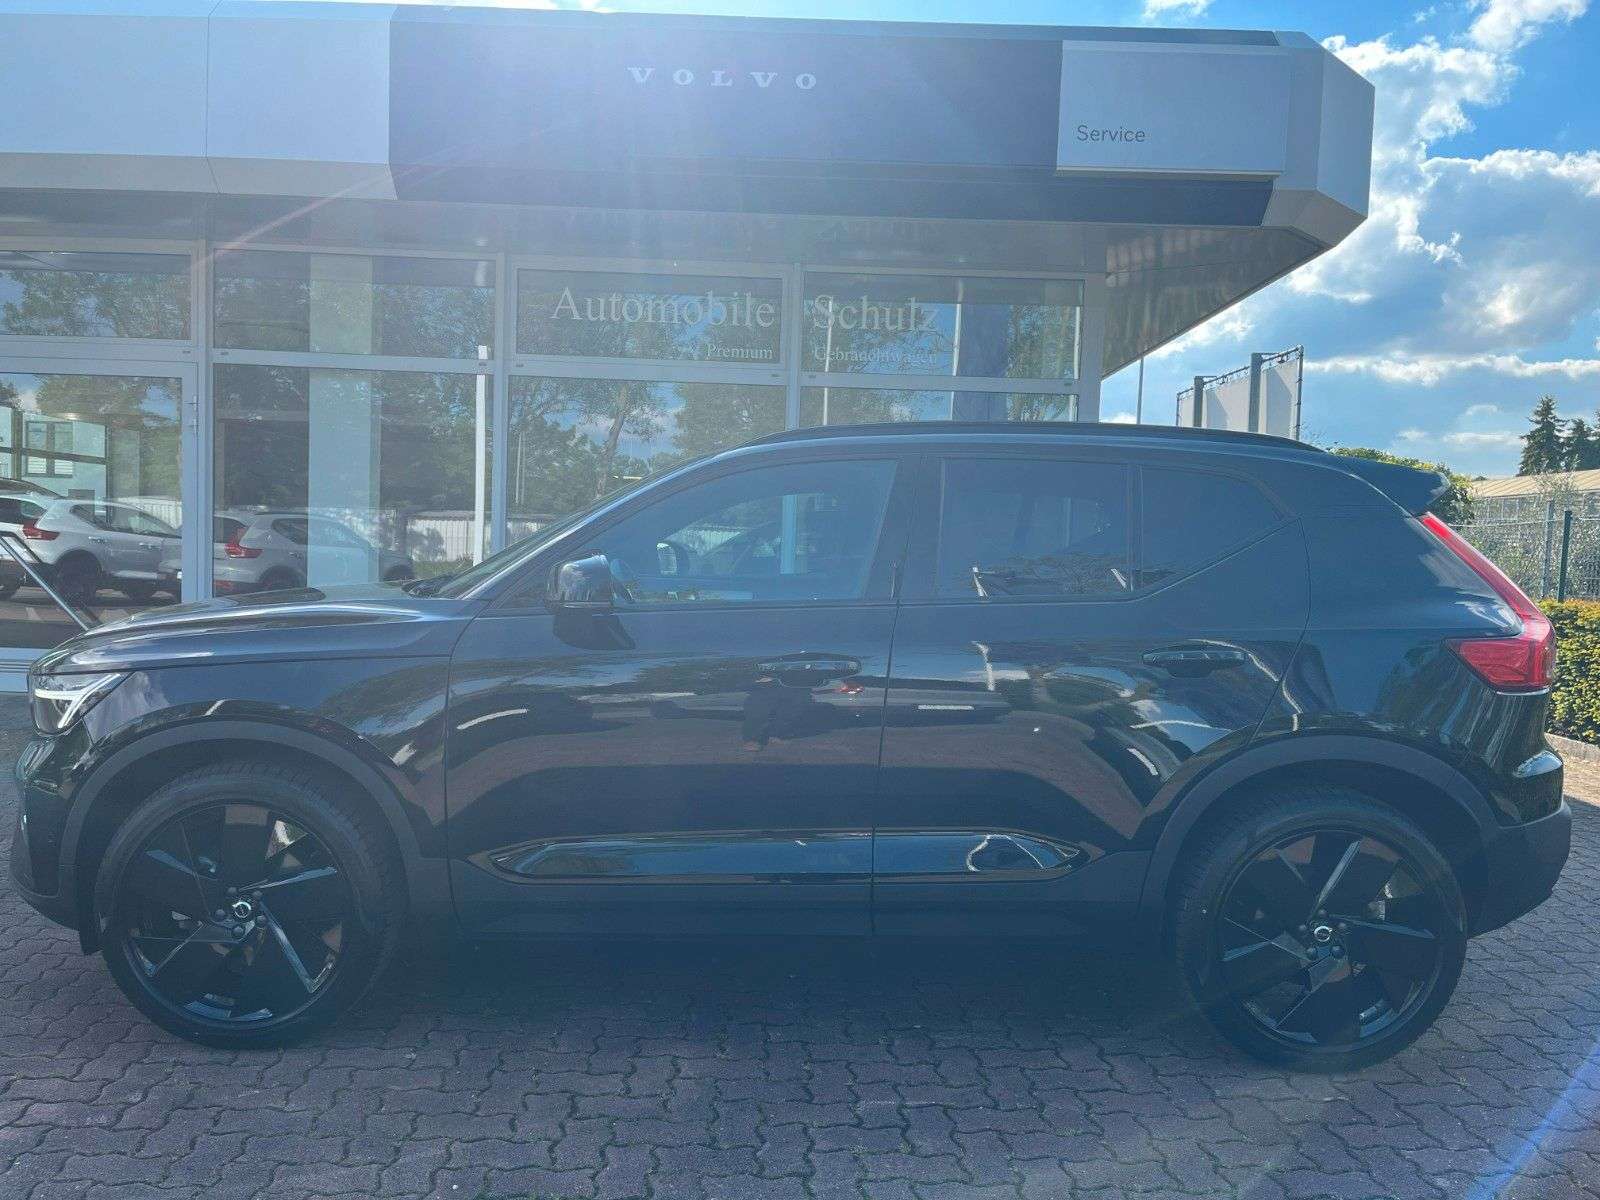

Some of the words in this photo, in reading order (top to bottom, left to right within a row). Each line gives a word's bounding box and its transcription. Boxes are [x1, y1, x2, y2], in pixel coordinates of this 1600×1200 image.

[627, 67, 817, 90] VOLVO
[1076, 124, 1146, 142] Service
[551, 286, 776, 328] Automobile
[813, 294, 938, 332] Schulz
[706, 343, 773, 361] Premium
